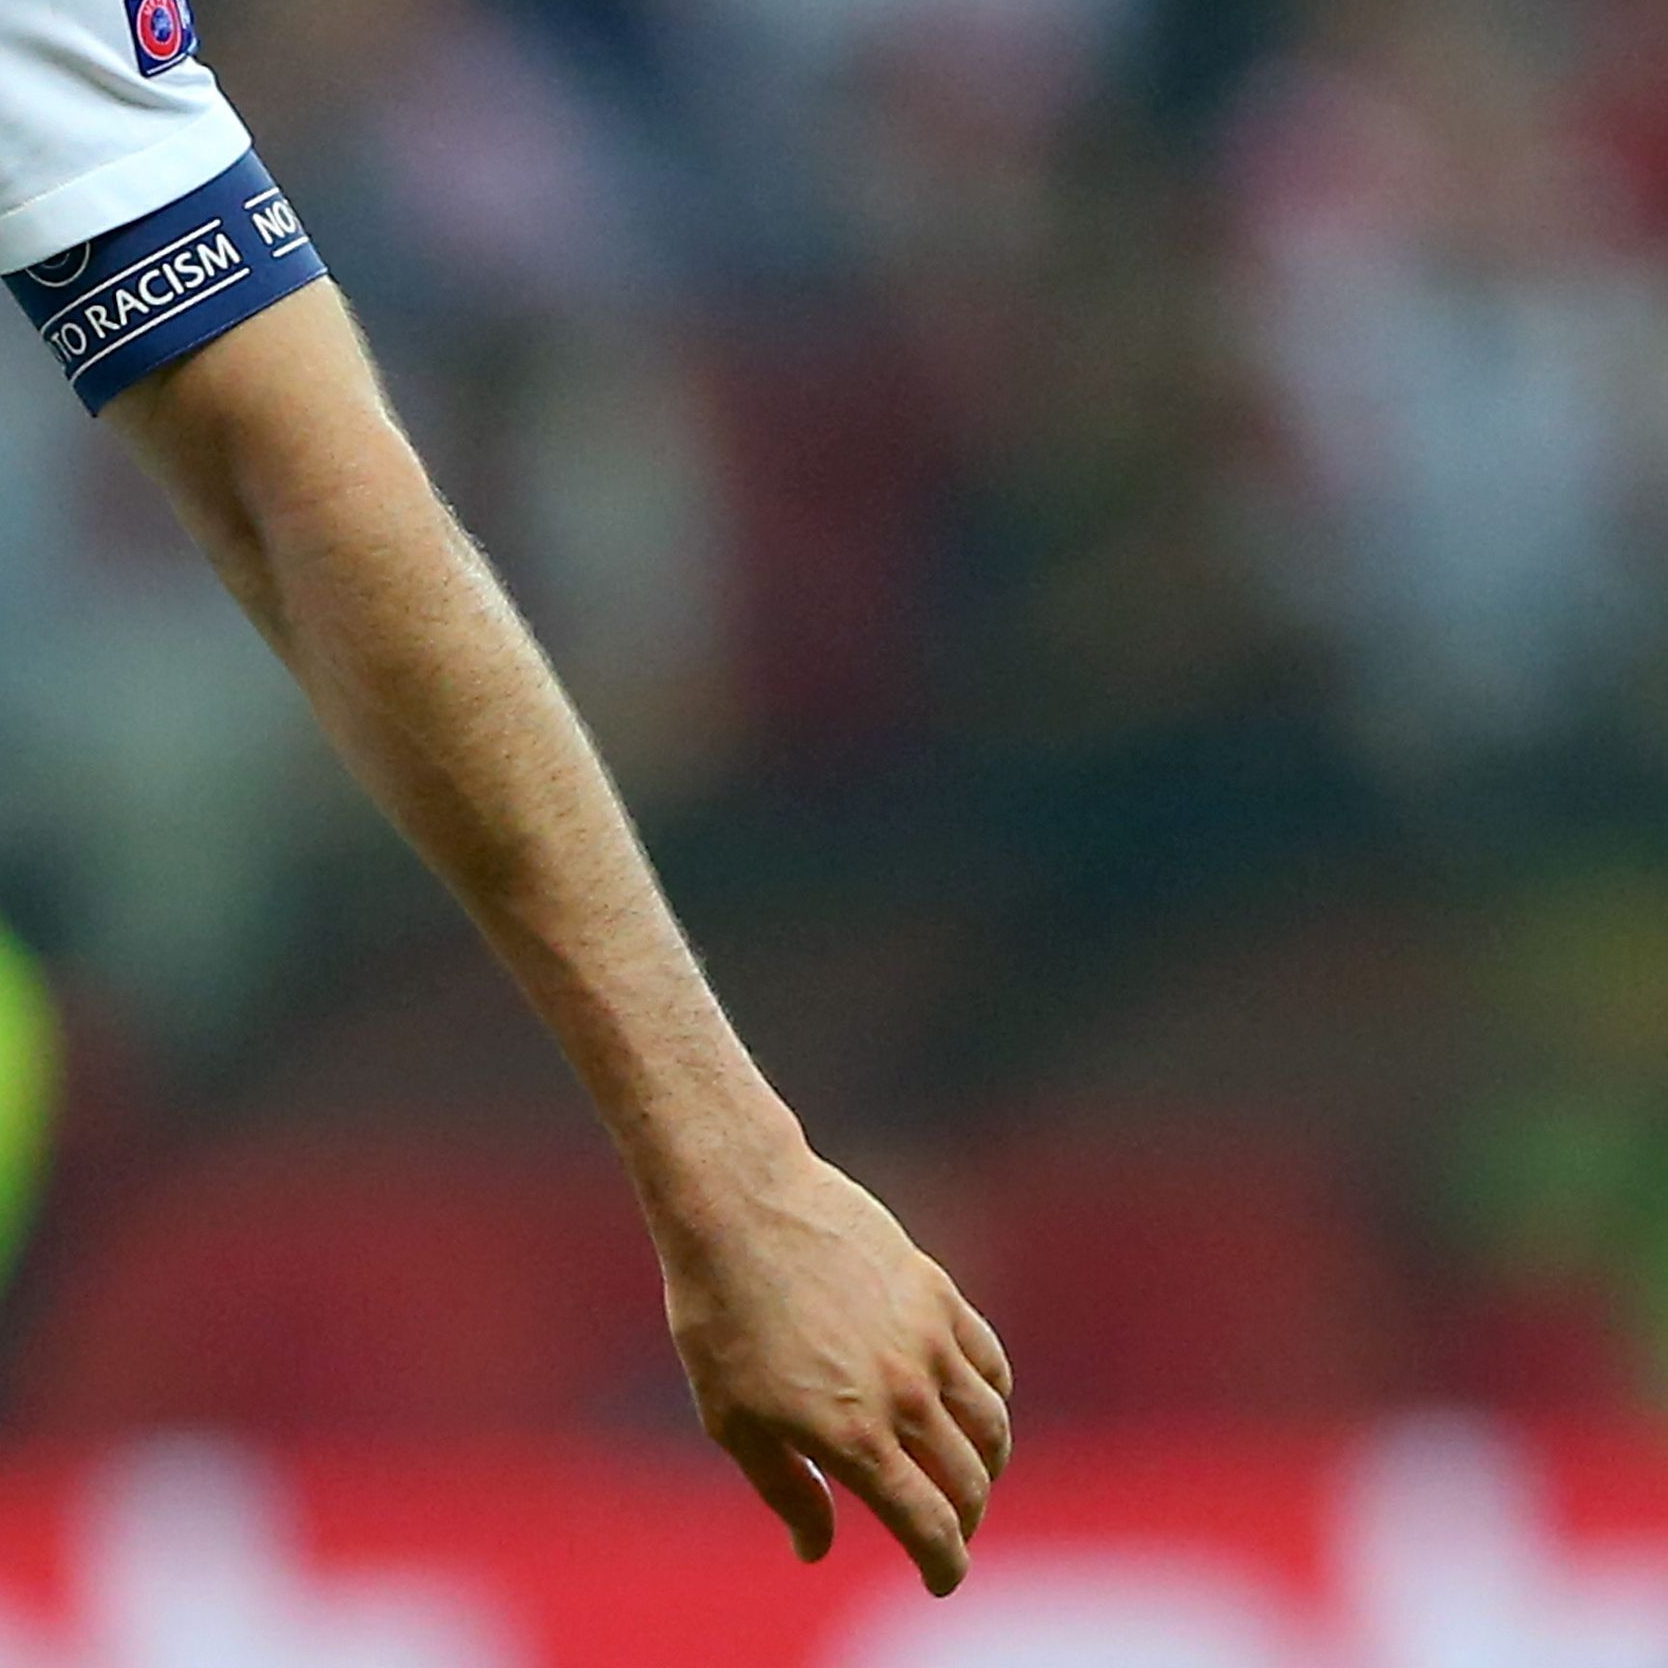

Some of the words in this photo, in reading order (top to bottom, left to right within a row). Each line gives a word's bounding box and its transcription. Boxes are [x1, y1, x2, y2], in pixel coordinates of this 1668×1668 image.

[252, 200, 297, 245] NO
[50, 322, 87, 363] TO
[84, 233, 242, 339] RACISM
